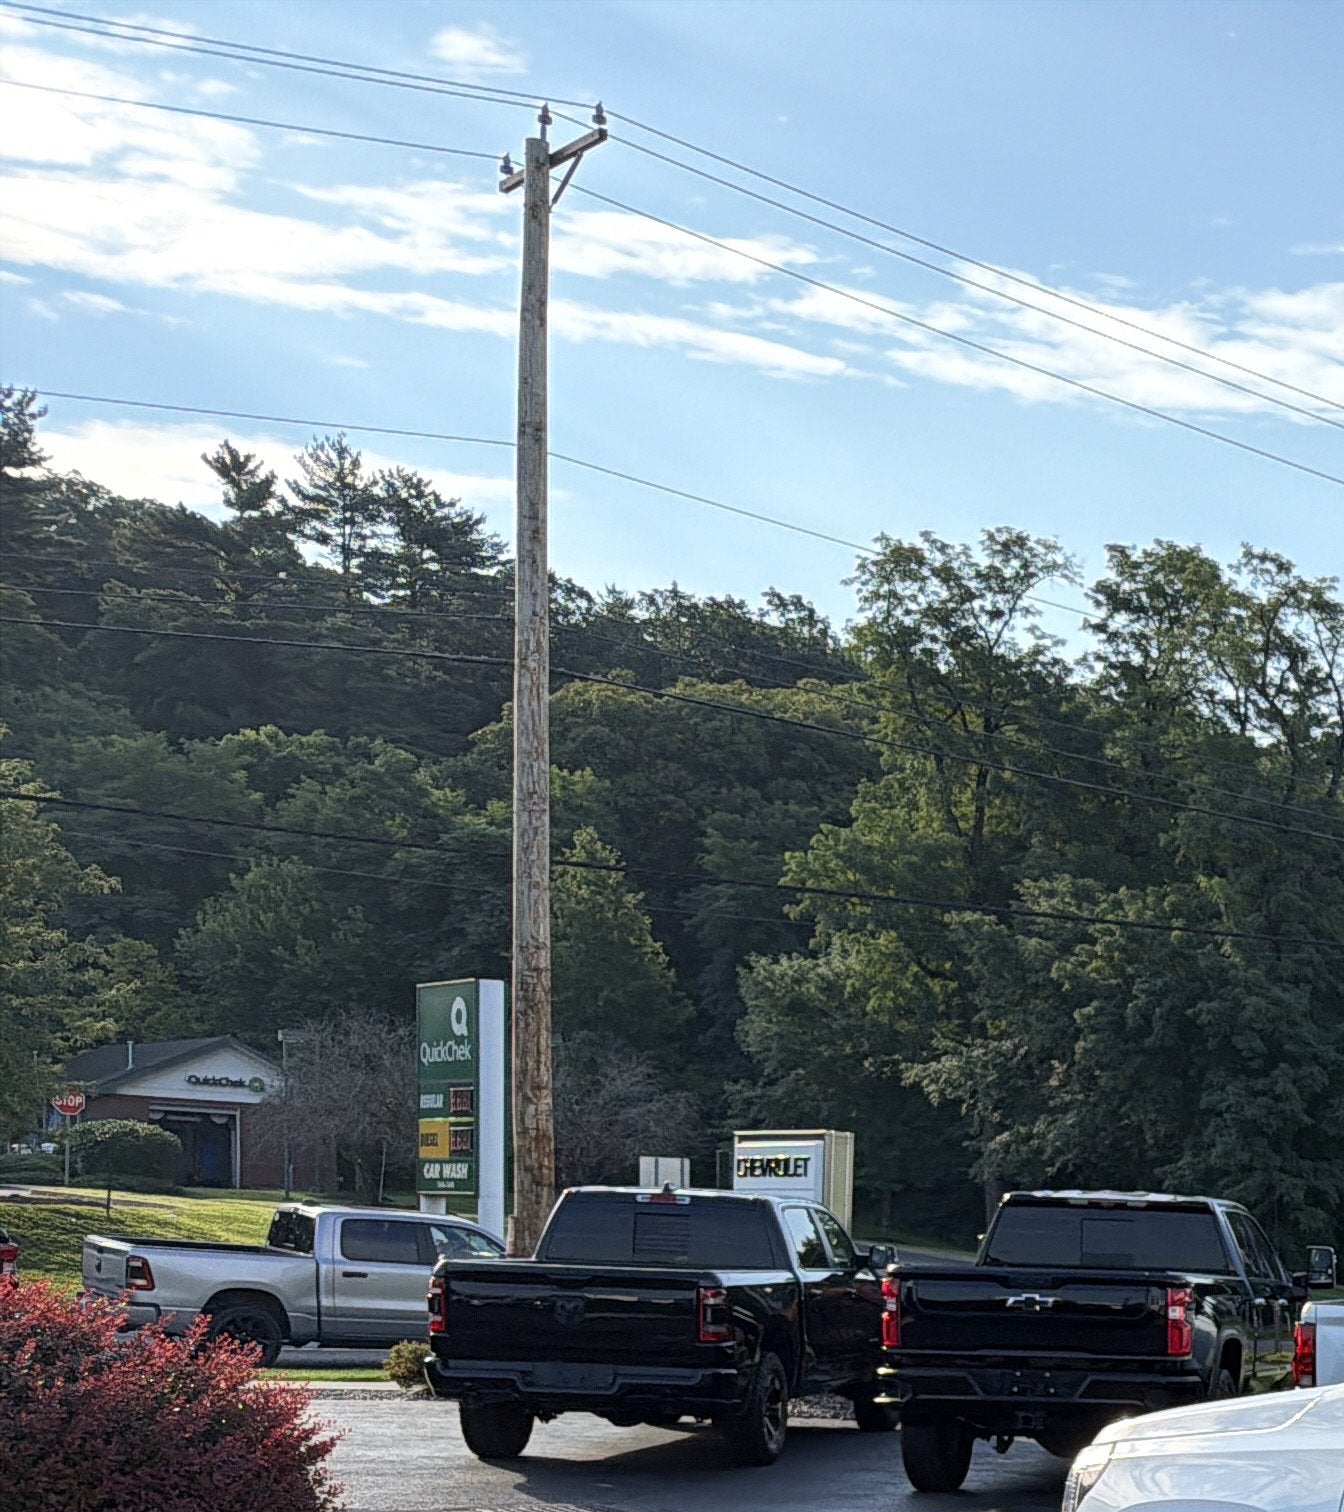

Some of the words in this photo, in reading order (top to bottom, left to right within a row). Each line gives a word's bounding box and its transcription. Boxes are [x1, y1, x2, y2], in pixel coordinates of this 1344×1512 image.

[450, 996, 468, 1037] Q
[420, 1039, 472, 1067] QuickChek
[54, 1094, 83, 1107] STOP
[423, 1162, 440, 1179] CAR
[442, 1162, 469, 1179] WASH
